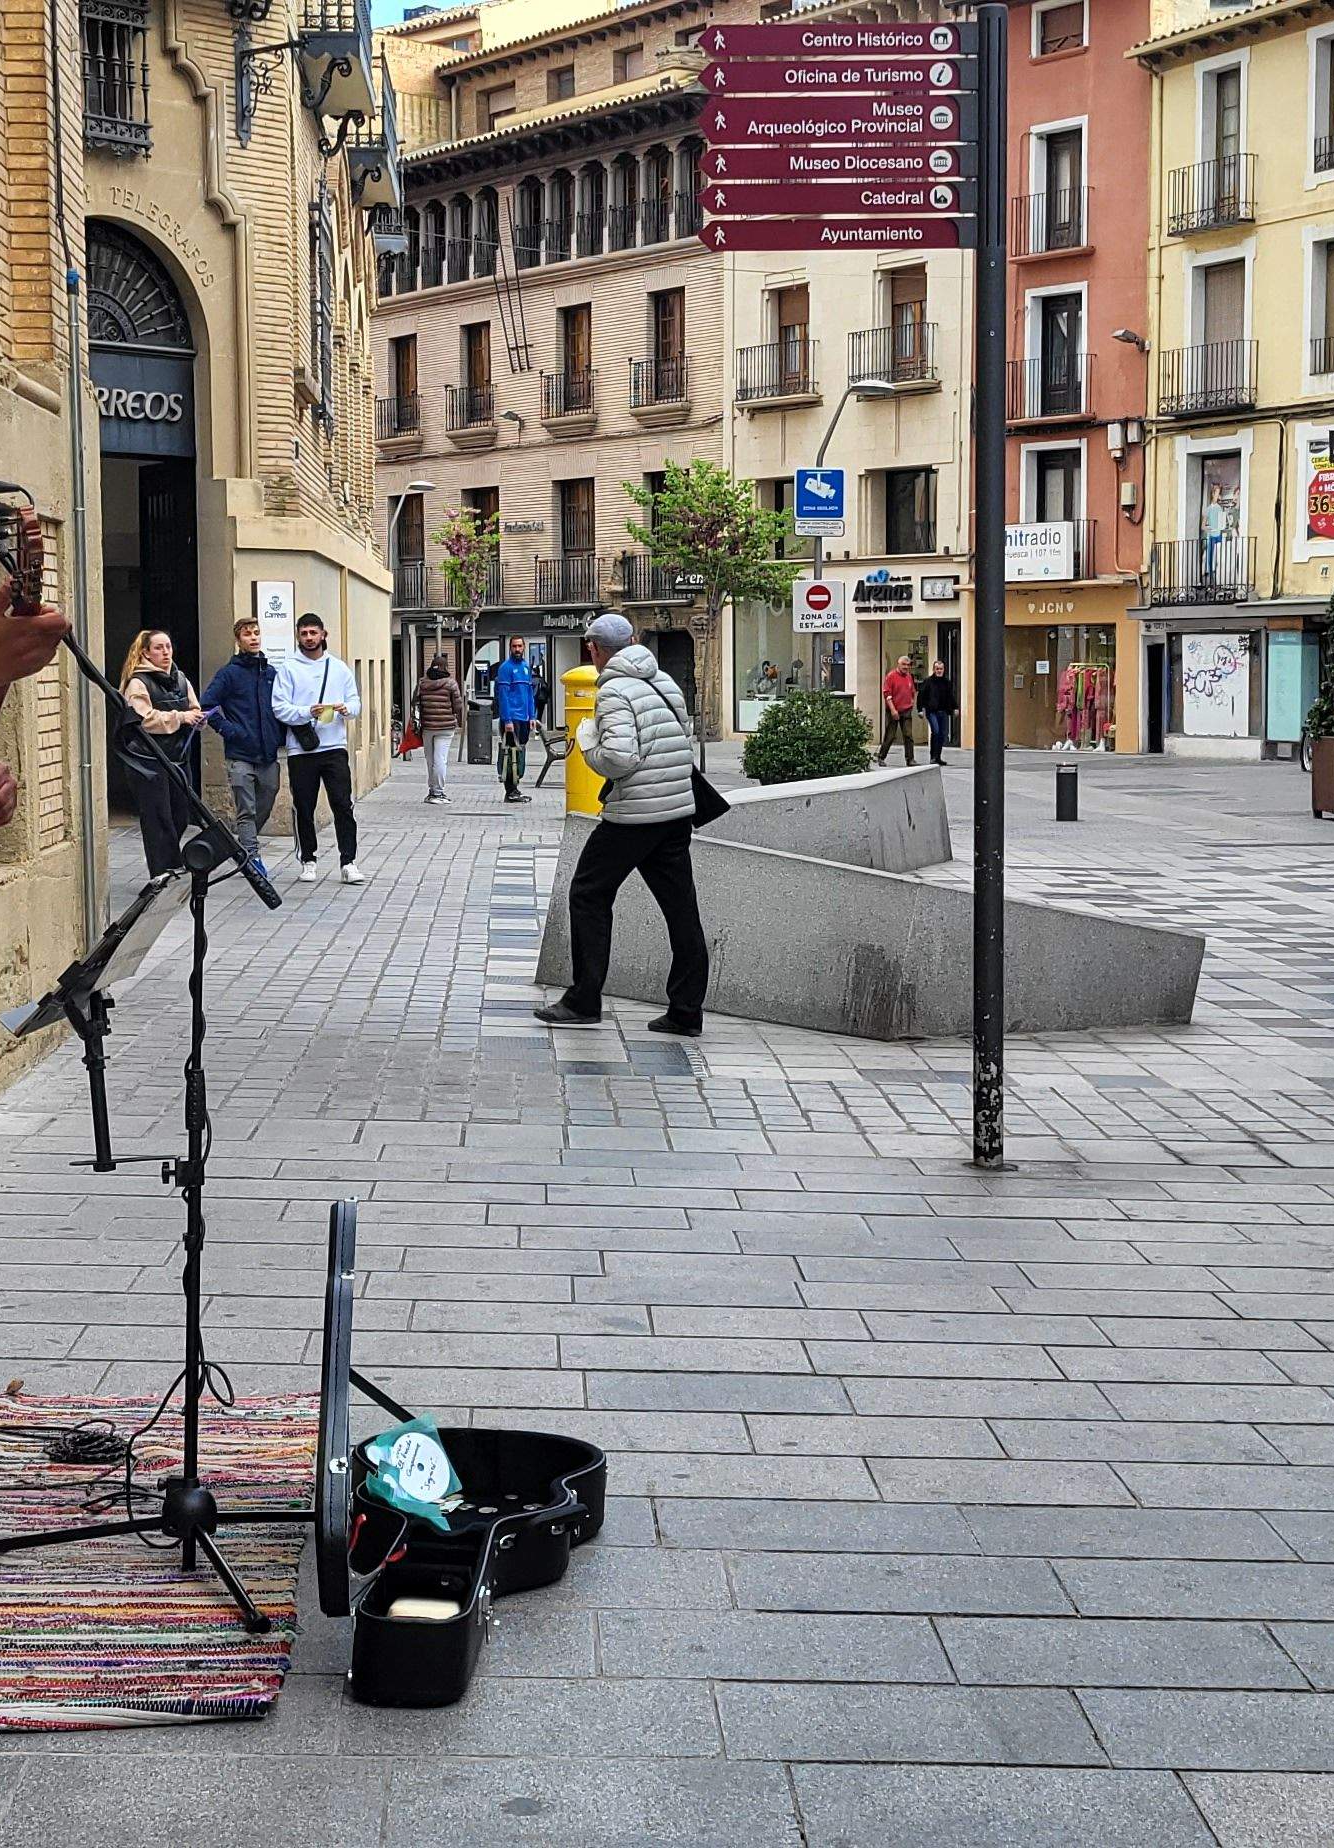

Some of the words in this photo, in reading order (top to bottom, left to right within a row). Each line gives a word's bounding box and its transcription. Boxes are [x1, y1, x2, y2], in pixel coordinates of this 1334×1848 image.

[802, 33, 853, 47] Centro
[857, 31, 924, 47] Histórico
[784, 69, 838, 84] Oficina
[841, 69, 861, 84] de
[864, 68, 924, 83] Turismo
[872, 102, 924, 117] Museo
[747, 119, 847, 137] Arqueológico
[851, 118, 924, 134] Provincial
[790, 156, 840, 171] Museo
[844, 156, 924, 170] Diocesano
[860, 191, 924, 206] Catedral
[820, 227, 923, 243] Ayuntamiento
[96, 387, 183, 421] RREOS
[675, 574, 704, 584] Aren
[852, 579, 913, 602] Arenas
[1039, 602, 1064, 614] JCN
